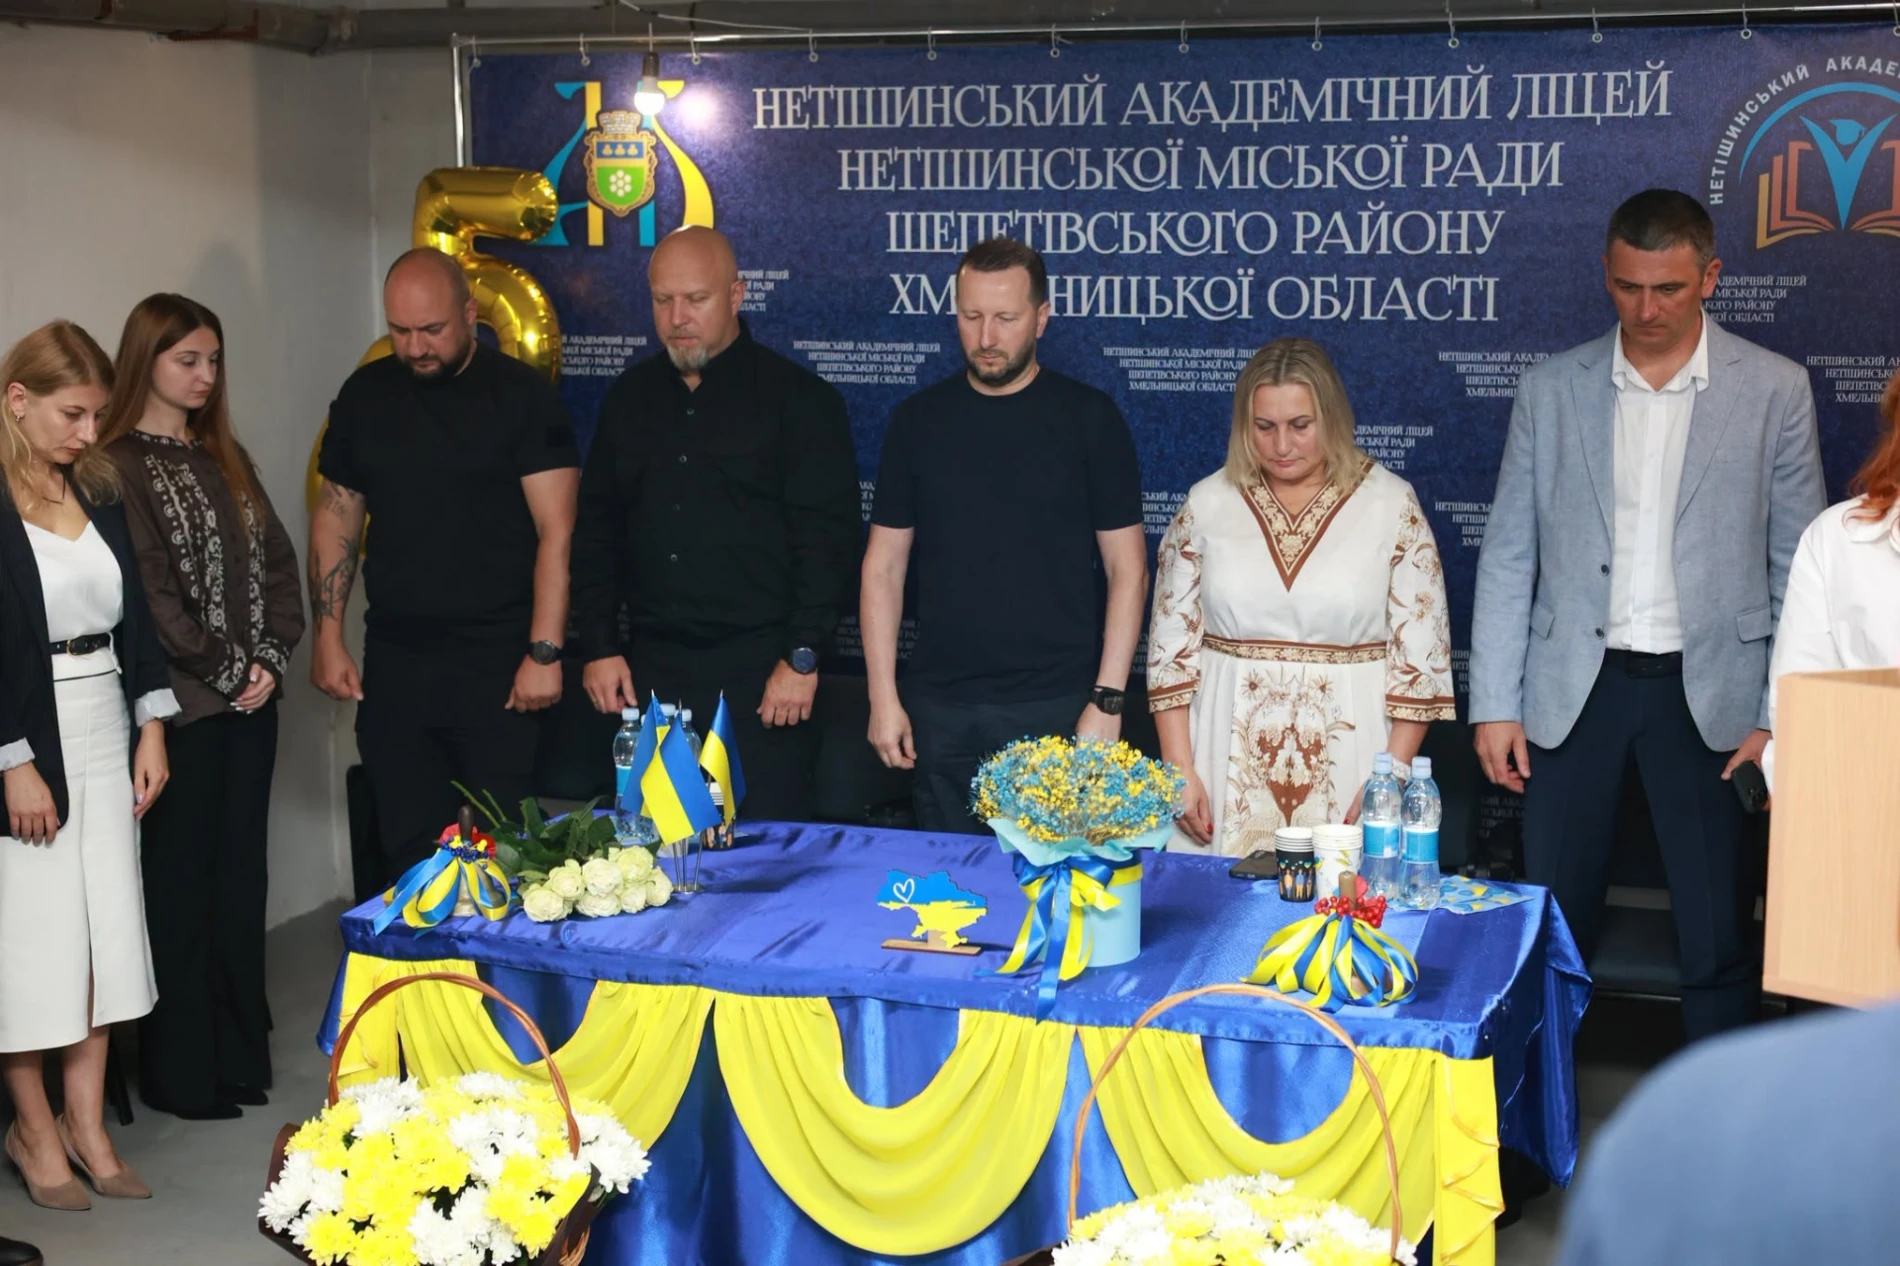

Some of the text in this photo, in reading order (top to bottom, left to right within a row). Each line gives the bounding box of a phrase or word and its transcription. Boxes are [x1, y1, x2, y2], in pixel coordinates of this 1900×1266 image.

[752, 60, 1673, 132] НЕТІШИНСЬКИЙ АКАДЕМІЧНИЙ ЛІЦЕЙ
[1710, 56, 1900, 204] НЕТІШИНСЬКИЙ АКАДЕ
[838, 135, 1565, 196] НЕТІШИНСЬКОЇ МІСЬКОЇ РАДИ
[886, 201, 1505, 256] ШЕПЕТІВСЬКОГО РАЙОНУ
[889, 268, 1499, 325] ХМНИЦЬКОЇ ОБЛАСТІ
[1717, 275, 1773, 287] ДЕМІЧНИЙ
[1825, 368, 1897, 379] НЕТІШИНСЬКО
[1835, 381, 1888, 391] ШЕПЕТІВС
[1353, 425, 1402, 436] ДЕМІЧНИЙ
